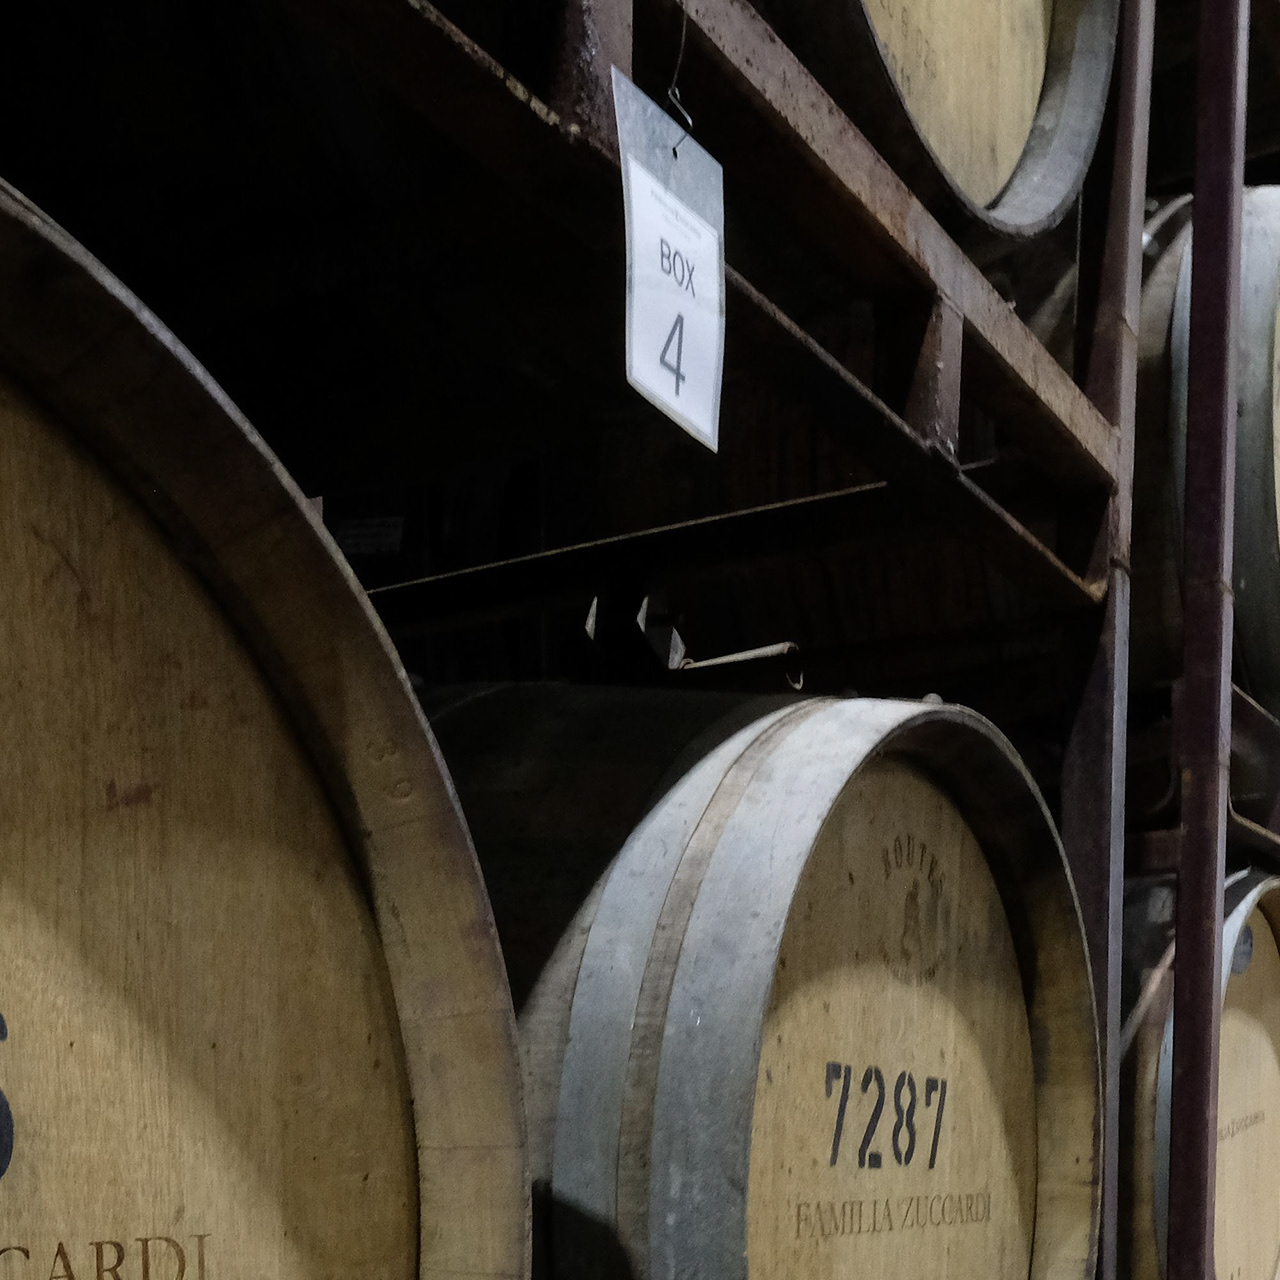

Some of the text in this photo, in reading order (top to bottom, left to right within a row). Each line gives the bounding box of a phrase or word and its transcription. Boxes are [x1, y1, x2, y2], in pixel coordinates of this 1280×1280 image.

[659, 236, 696, 298] BOX
[659, 311, 686, 397] 4
[825, 1060, 948, 1170] 7287
[795, 1192, 992, 1240] FAMILIA ZUCCARDI
